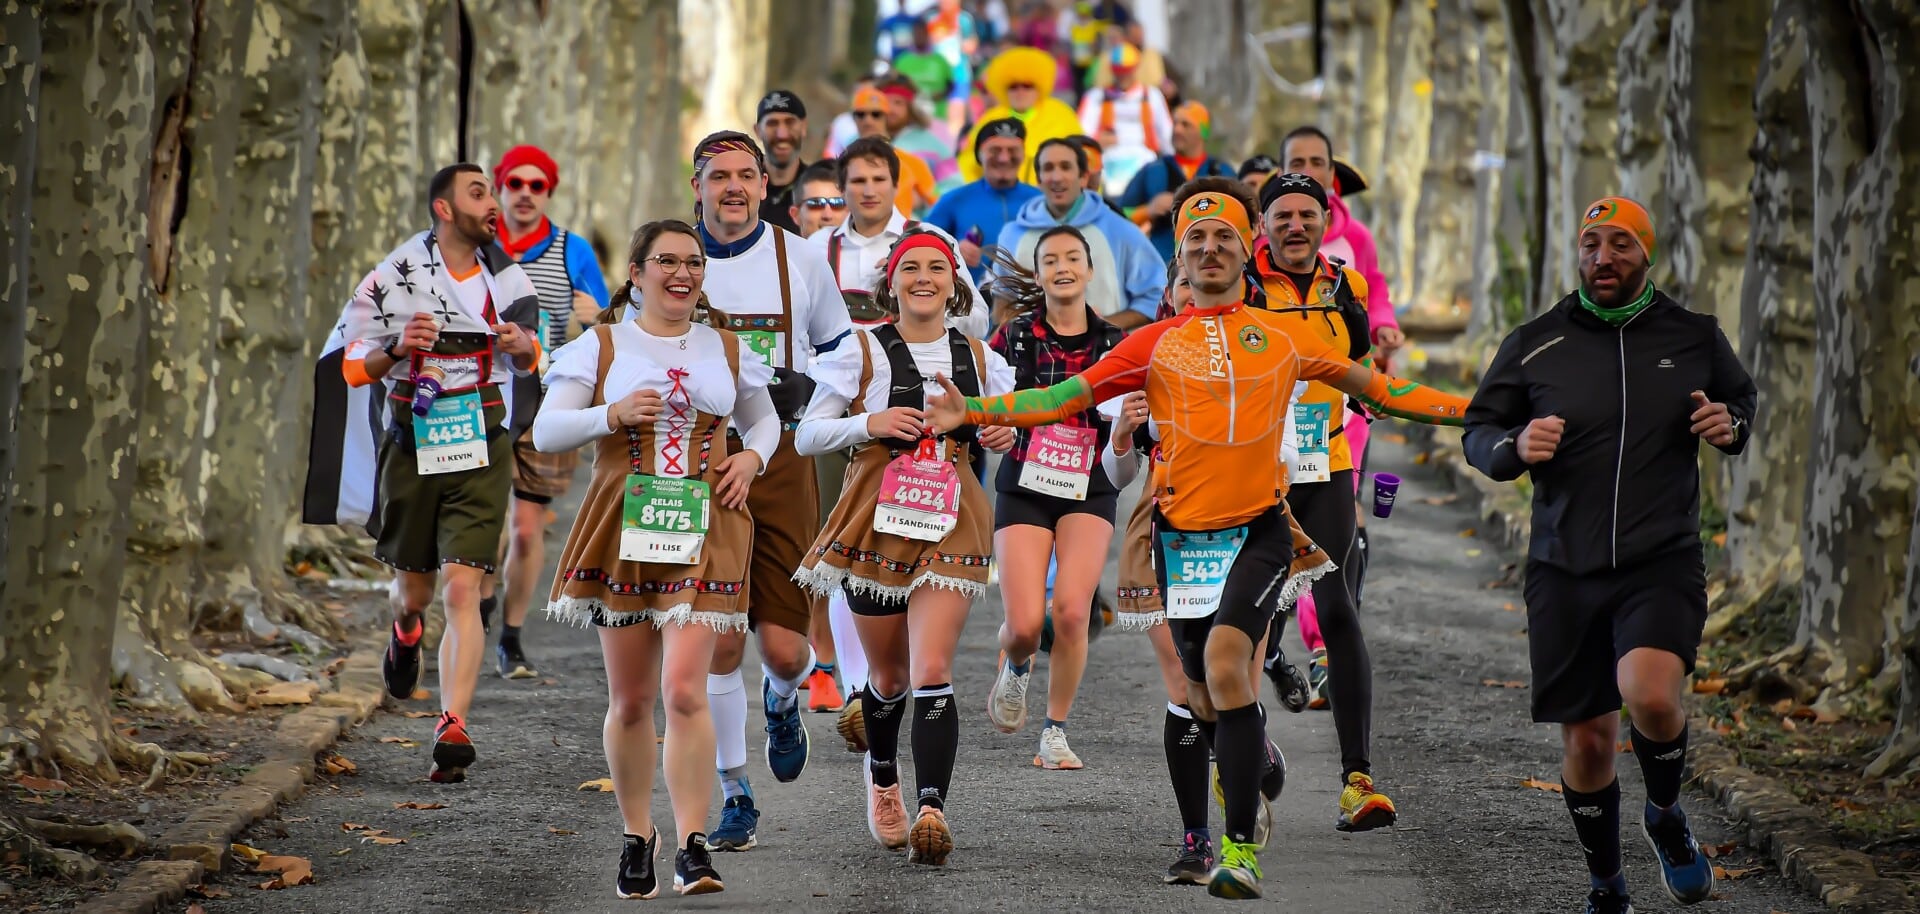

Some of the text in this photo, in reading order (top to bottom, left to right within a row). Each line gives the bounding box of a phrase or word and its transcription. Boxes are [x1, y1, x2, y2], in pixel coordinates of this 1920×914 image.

[426, 413, 472, 425] MARATHON
[428, 423, 474, 444] 4425
[1296, 433, 1314, 448] 21
[1042, 437, 1083, 452] MARATHON
[447, 452, 473, 462] KEVIN
[1037, 447, 1082, 468] 4426
[897, 475, 948, 490] MARATHON
[1046, 478, 1075, 488] ALISON
[651, 498, 683, 507] RELAIS
[894, 485, 946, 511] 4024
[641, 504, 691, 531] 8175
[898, 518, 946, 532] SANDRINE
[662, 543, 682, 551] LISE
[1180, 550, 1233, 558] MARATHON
